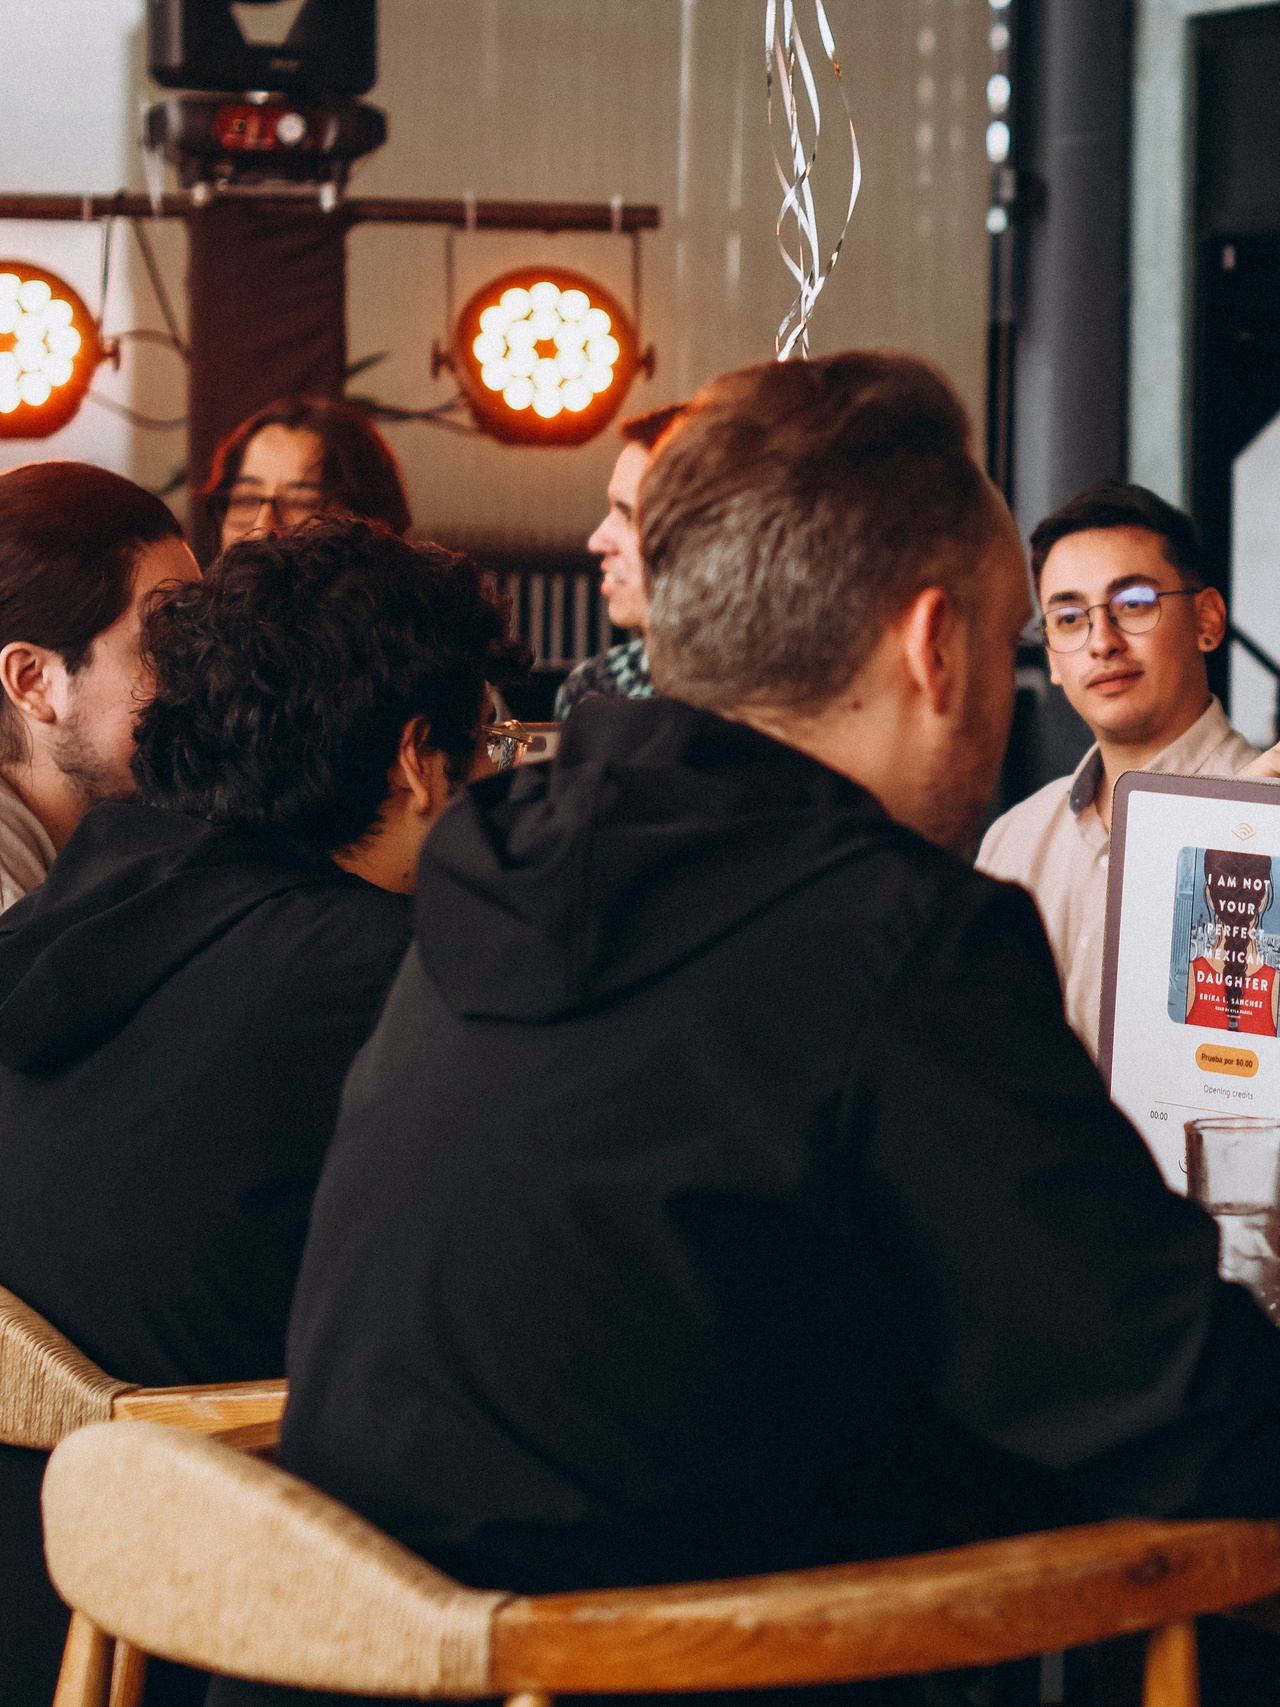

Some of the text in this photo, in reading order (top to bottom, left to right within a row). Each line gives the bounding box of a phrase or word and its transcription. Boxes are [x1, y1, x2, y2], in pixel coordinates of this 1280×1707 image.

[1208, 873, 1270, 892] I AM NOT
[1219, 899, 1255, 915] YOUR
[1207, 923, 1265, 941] PERFECT
[1203, 947, 1264, 965] MEXICAN
[1197, 970, 1269, 992] DAUGHTER
[1199, 993, 1220, 1002] ERIKA
[1222, 996, 1229, 1004] L.
[1201, 1053, 1253, 1068] Prueba por $0.00
[1203, 1084, 1254, 1100] Opening credits
